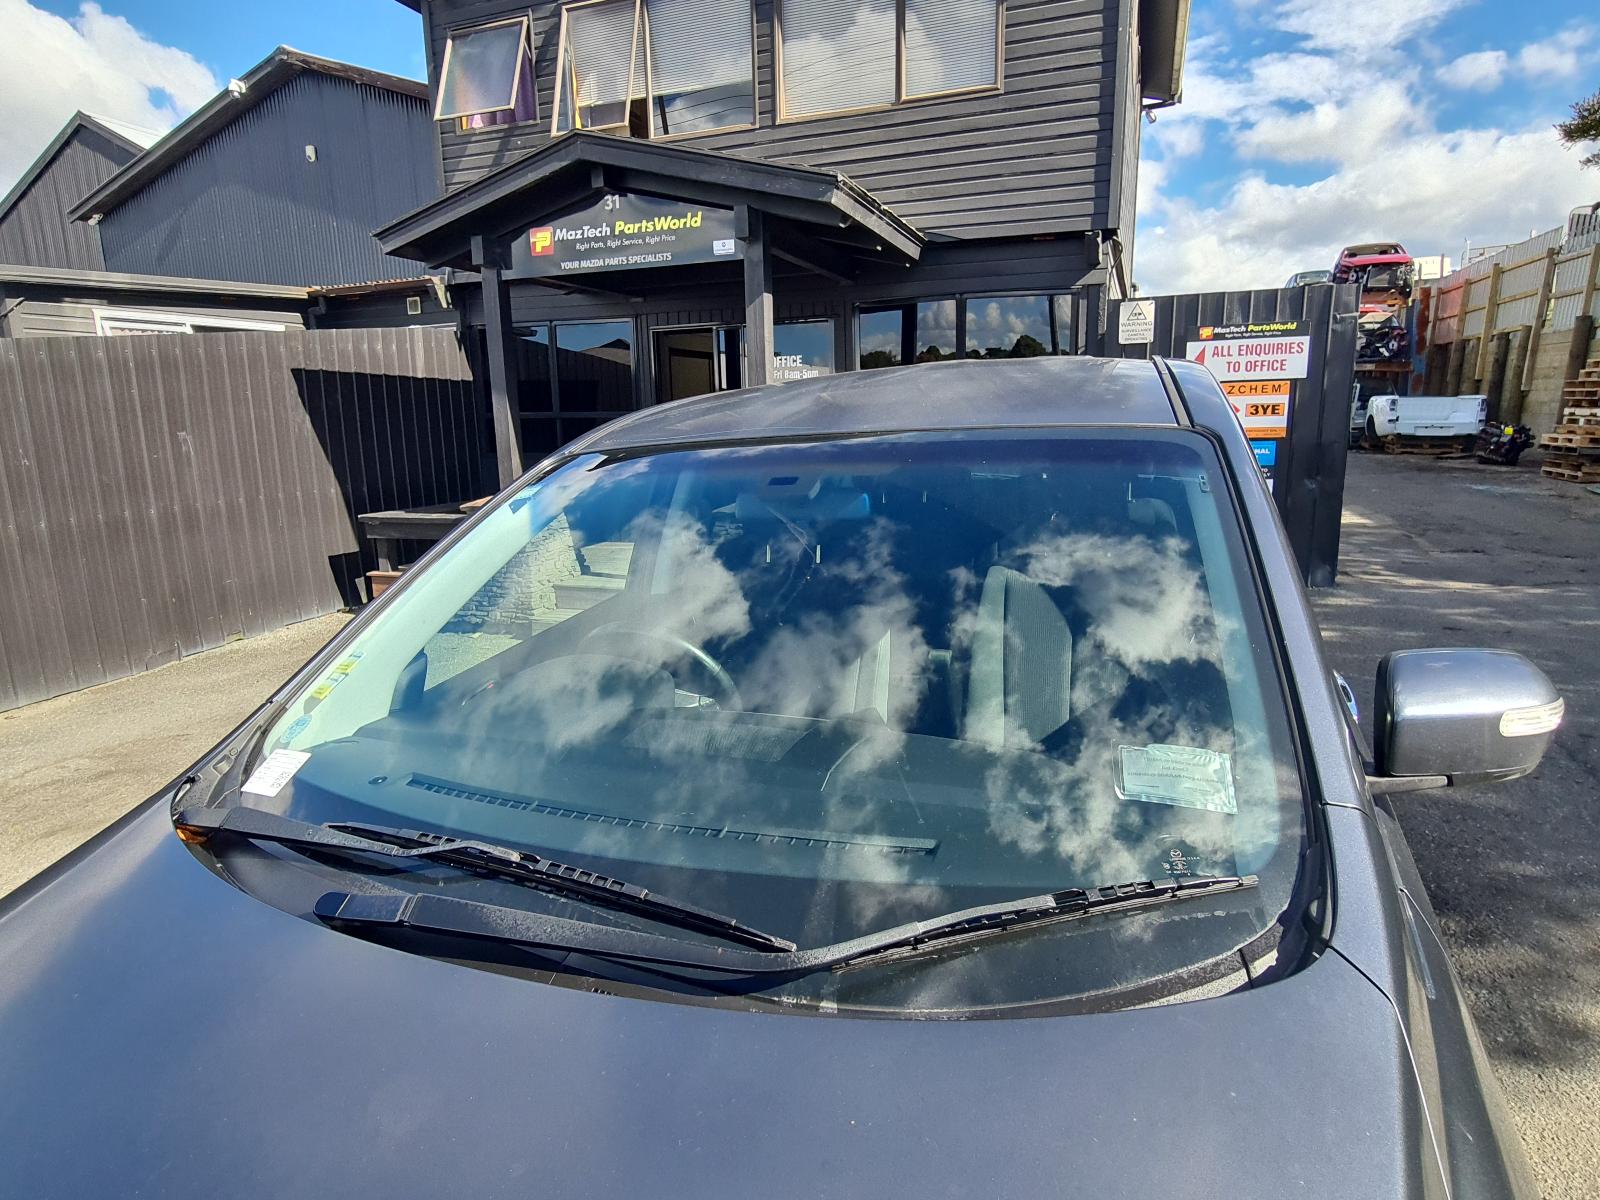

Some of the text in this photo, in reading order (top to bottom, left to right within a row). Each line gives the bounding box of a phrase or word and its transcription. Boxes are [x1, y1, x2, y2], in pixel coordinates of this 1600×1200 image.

[604, 194, 620, 210] 31
[554, 211, 702, 241] MazTech PartsWorld
[576, 242, 589, 251] Right
[606, 239, 621, 248] Right
[646, 236, 660, 244] Right
[560, 252, 672, 270] YOUR MAZDA PARTS SPECIALISTS
[1247, 322, 1298, 332] PartsWorld
[1212, 342, 1304, 358] ALL ENQUIRIES
[1226, 359, 1287, 374] TO OFFICE
[1250, 404, 1280, 415] 3YE
